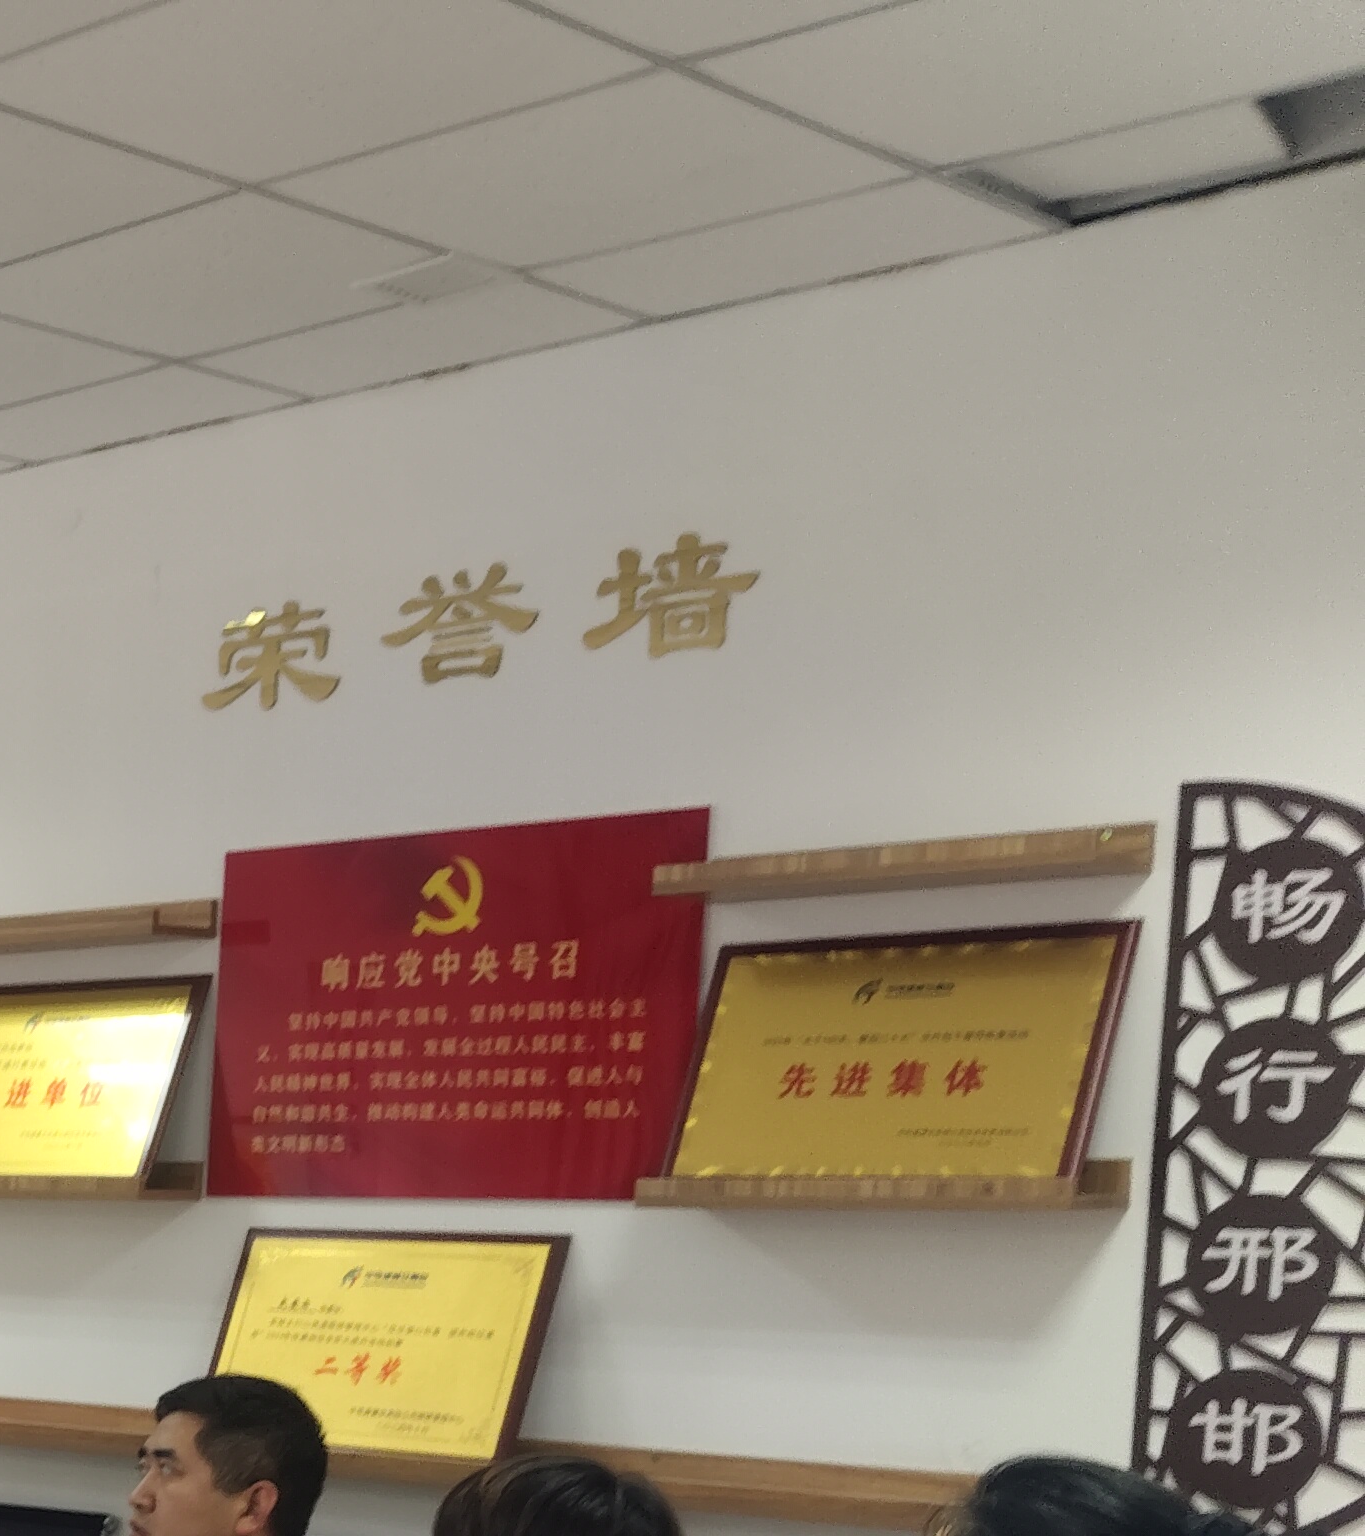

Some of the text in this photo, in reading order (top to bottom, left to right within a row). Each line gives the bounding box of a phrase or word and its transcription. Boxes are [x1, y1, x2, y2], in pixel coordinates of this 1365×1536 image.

[202, 533, 759, 710] 荣誉墙
[320, 938, 580, 992] 响应党中央号召
[775, 1056, 989, 1100] 先进集体
[1190, 866, 1346, 1477] 畅行邢邯
[313, 1352, 402, 1387] 二等奖
